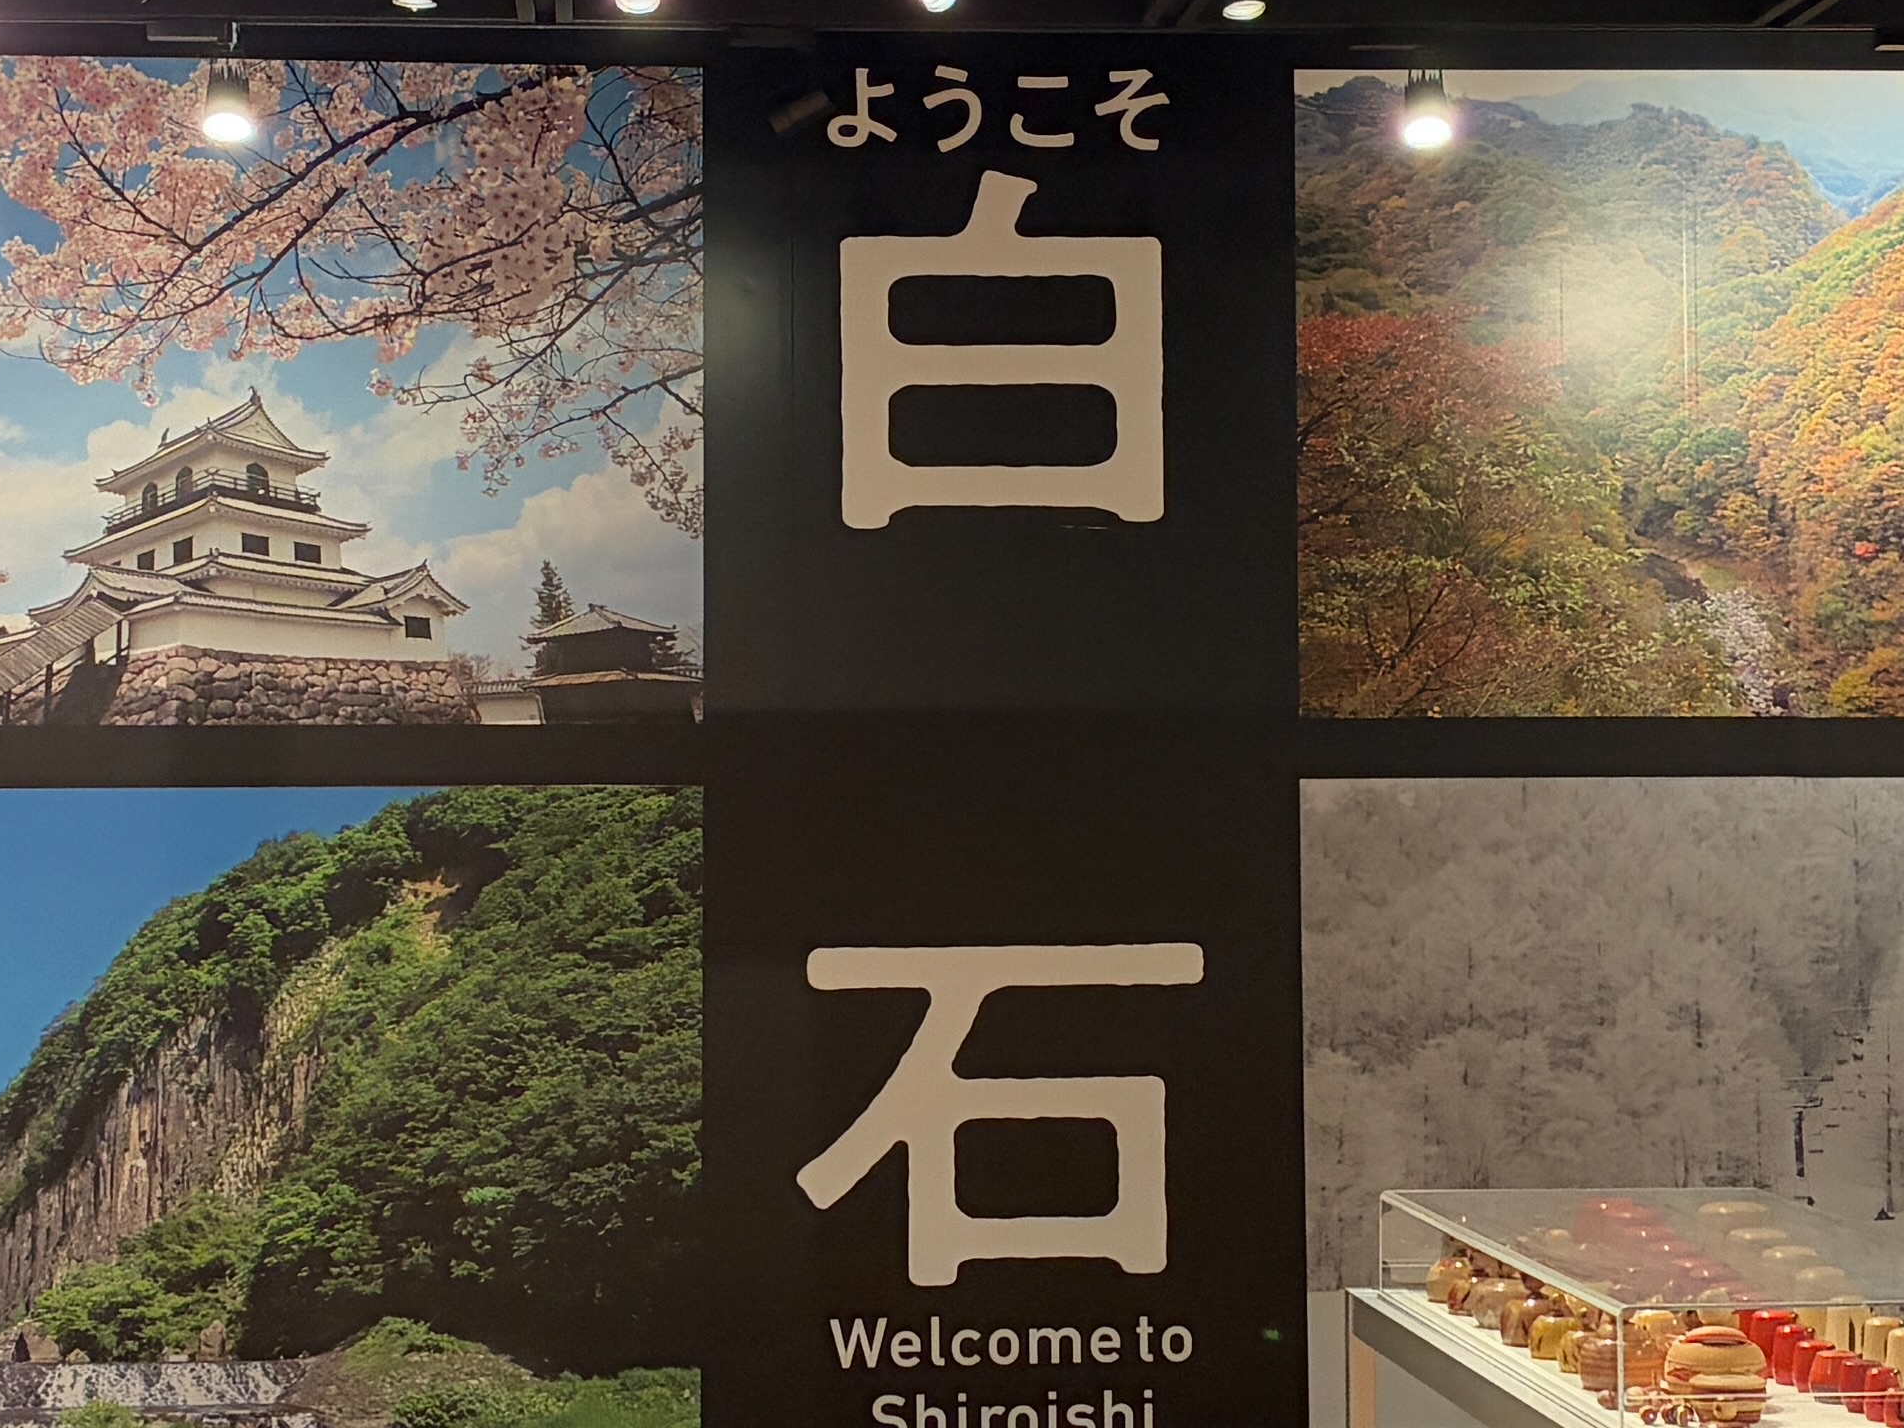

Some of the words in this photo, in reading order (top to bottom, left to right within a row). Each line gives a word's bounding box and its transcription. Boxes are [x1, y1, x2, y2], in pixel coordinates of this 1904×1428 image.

[827, 65, 1170, 152] ようこそ
[829, 1316, 1122, 1369] Welcome
[1136, 1316, 1193, 1363] to
